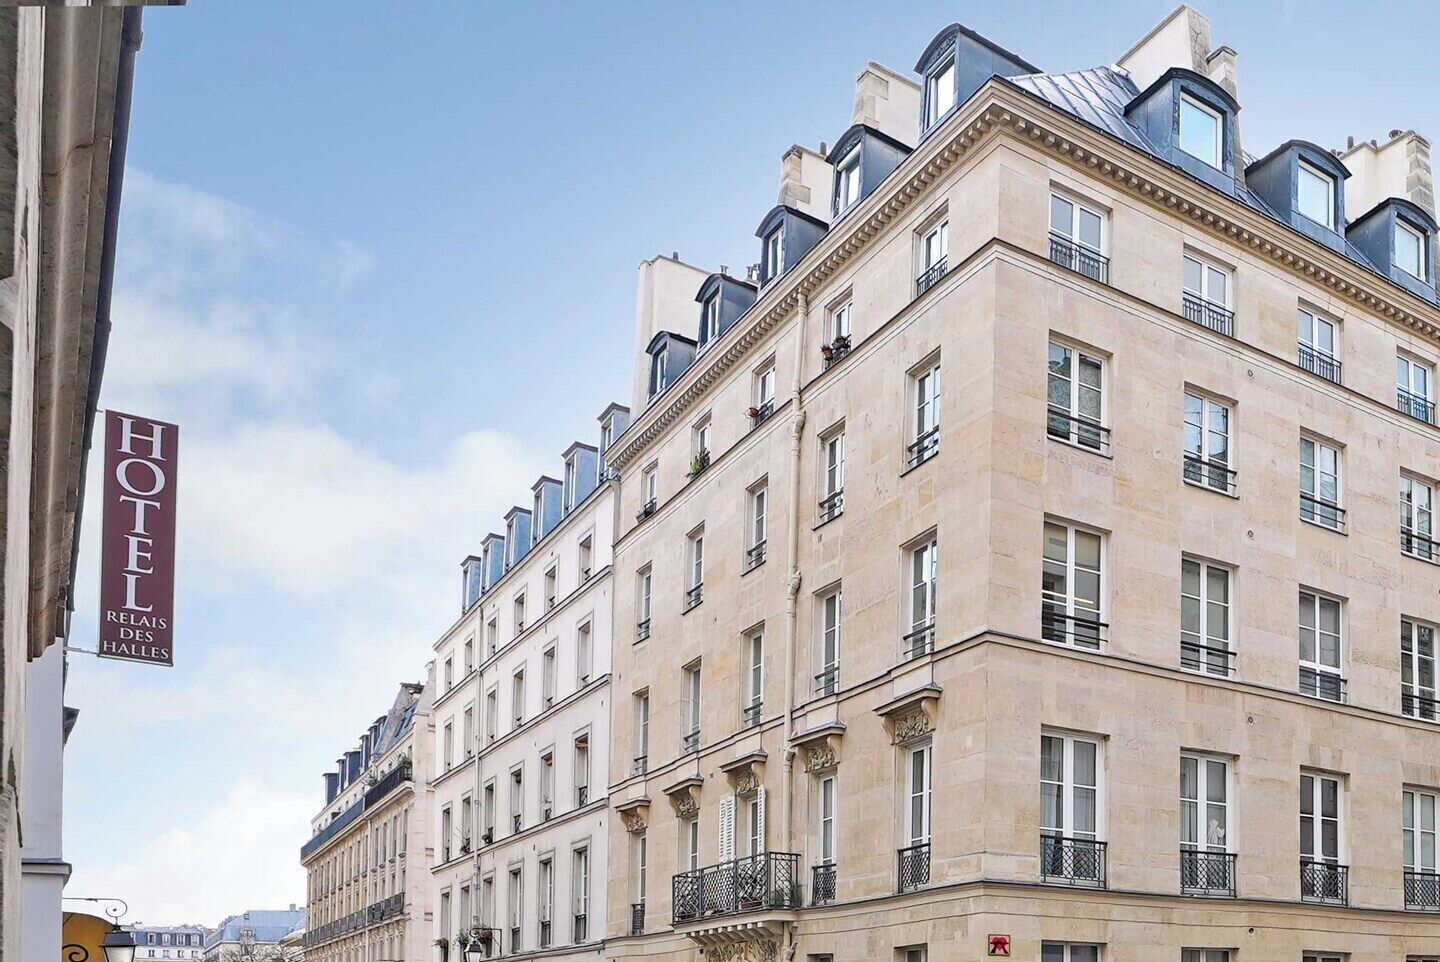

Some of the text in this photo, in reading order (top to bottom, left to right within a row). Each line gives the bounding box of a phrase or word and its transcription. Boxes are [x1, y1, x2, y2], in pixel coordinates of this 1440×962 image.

[115, 416, 167, 612] HOTEL
[107, 610, 167, 629] RELAIS
[120, 627, 153, 643] DES
[103, 640, 169, 660] HALLES
